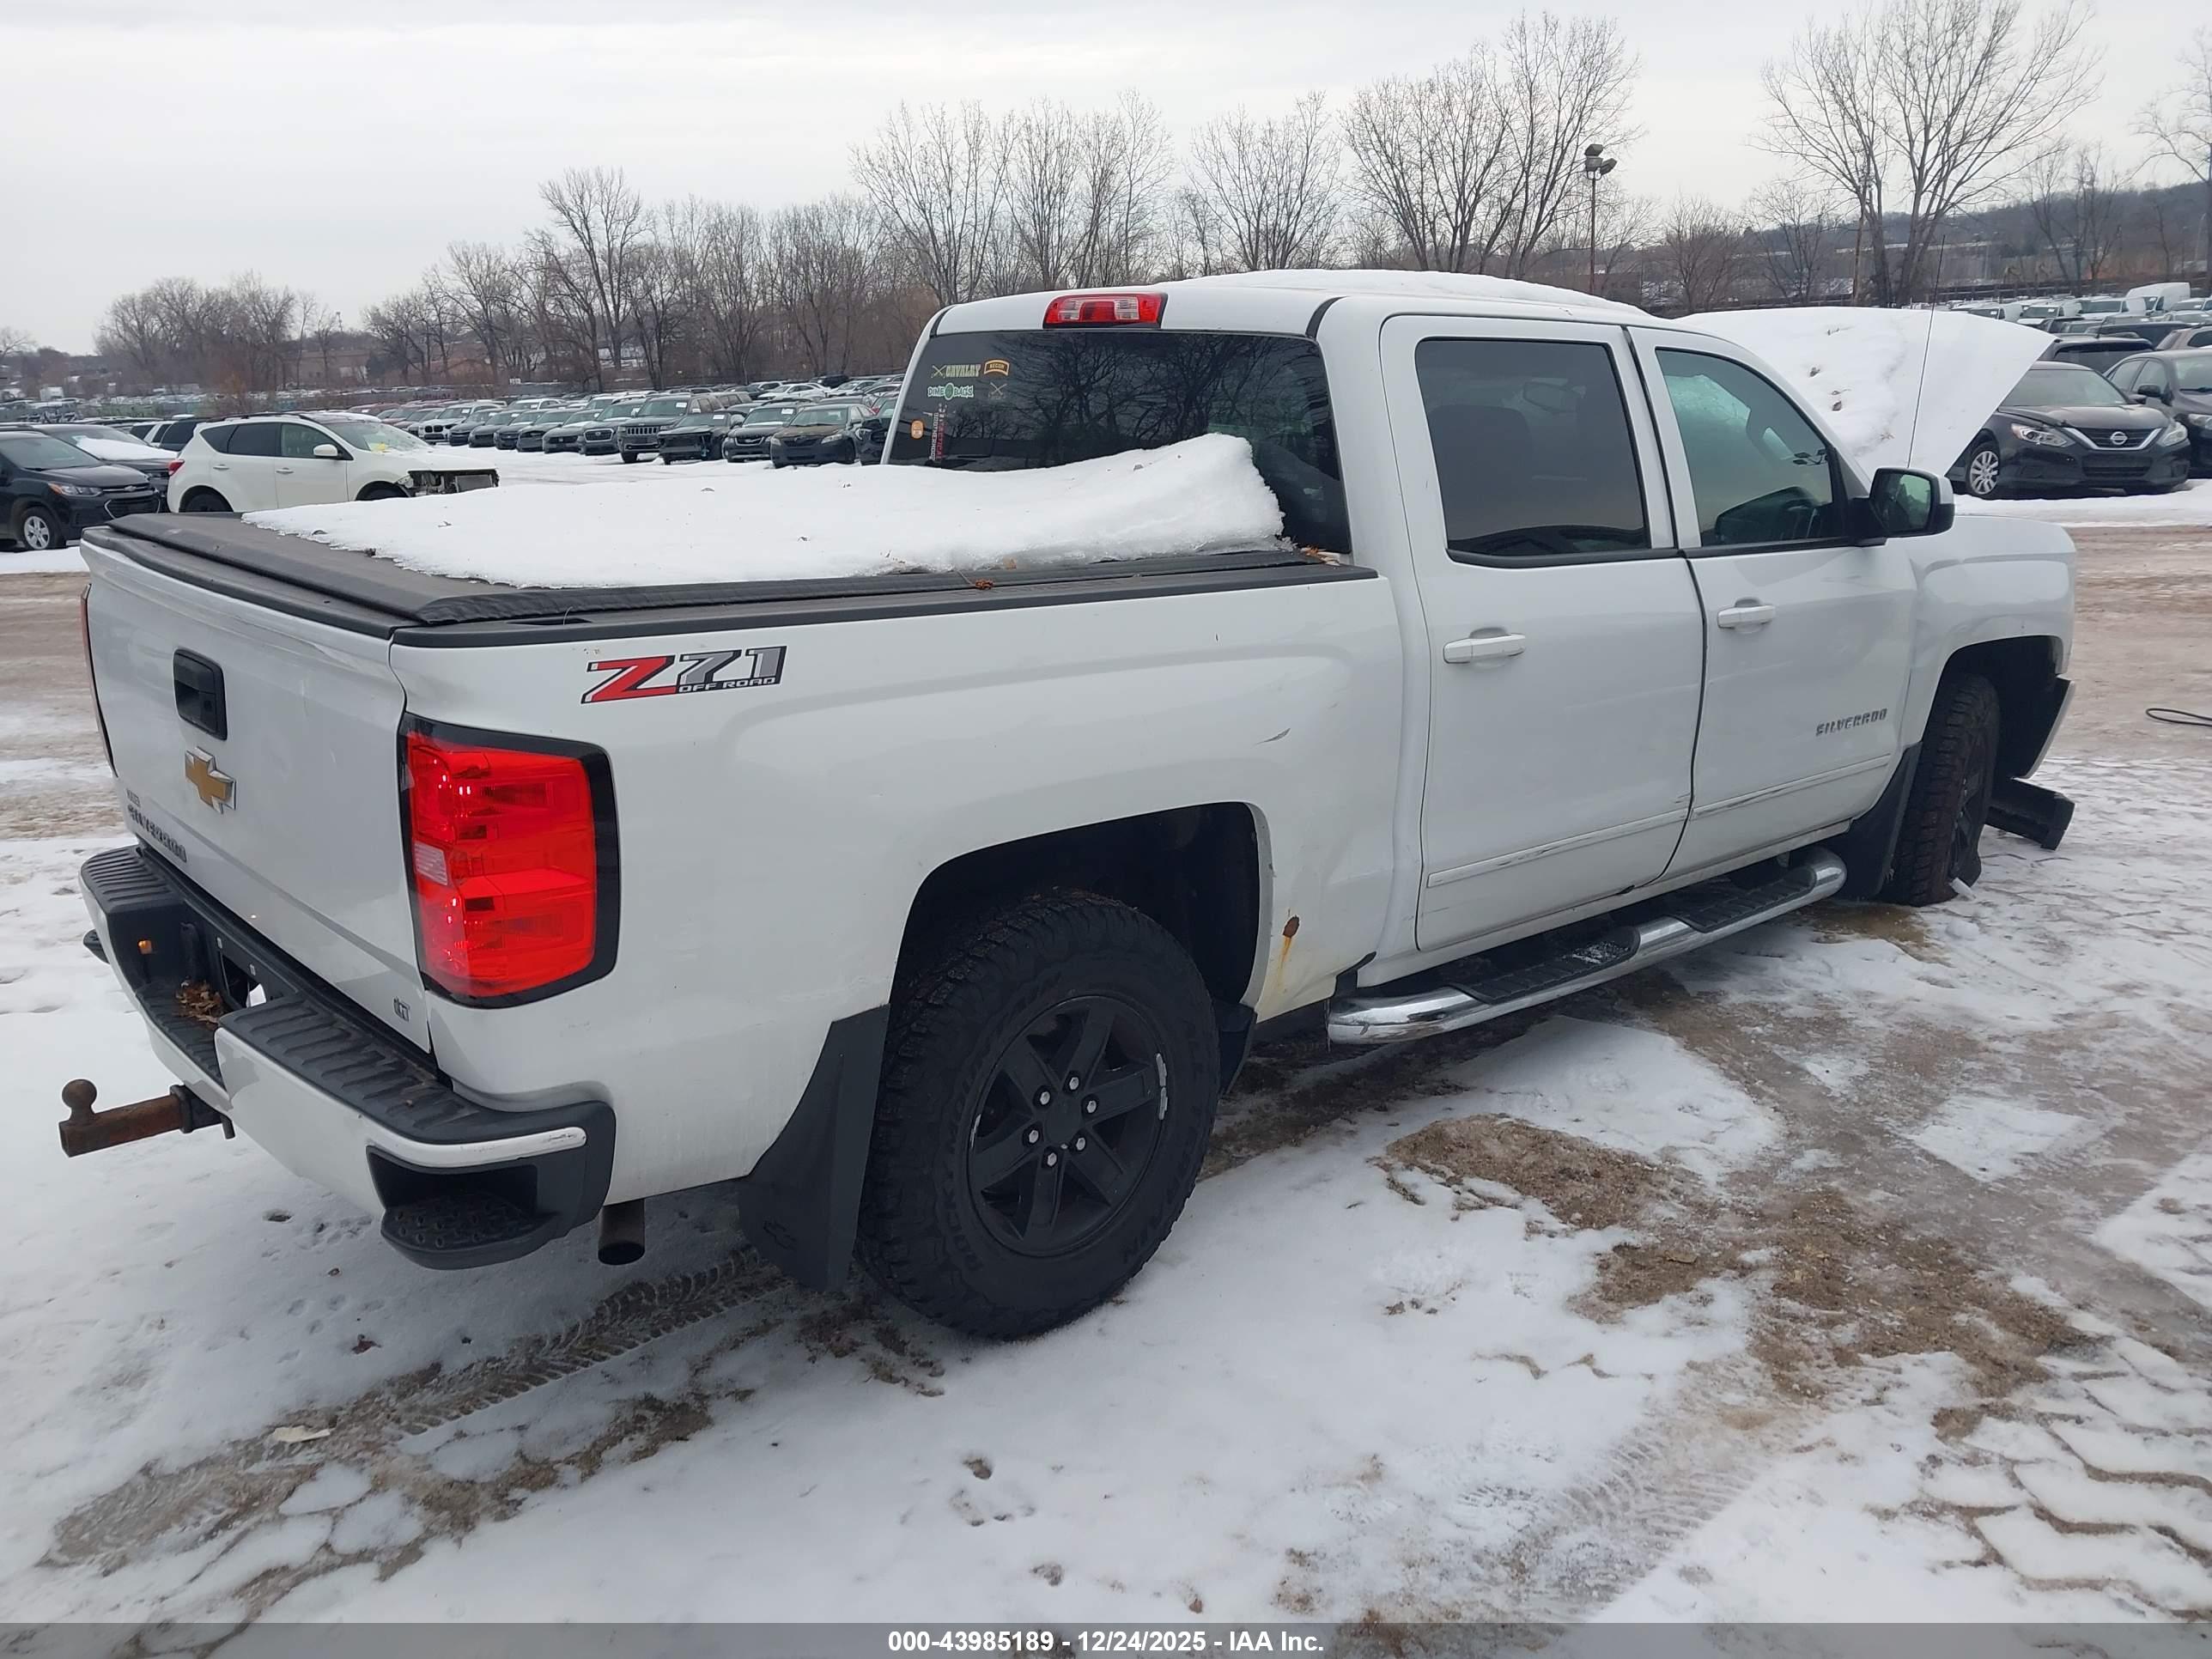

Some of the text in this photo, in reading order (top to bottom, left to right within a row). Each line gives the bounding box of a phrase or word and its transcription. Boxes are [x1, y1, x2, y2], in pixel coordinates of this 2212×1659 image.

[945, 364, 981, 378] CAVALRY
[927, 386, 945, 398] DIME
[953, 386, 974, 398] BAGS
[580, 645, 787, 704] Z71
[678, 677, 776, 693] OFF ROAD
[1815, 708, 1888, 737] SILVERADO
[393, 997, 411, 1022] LT
